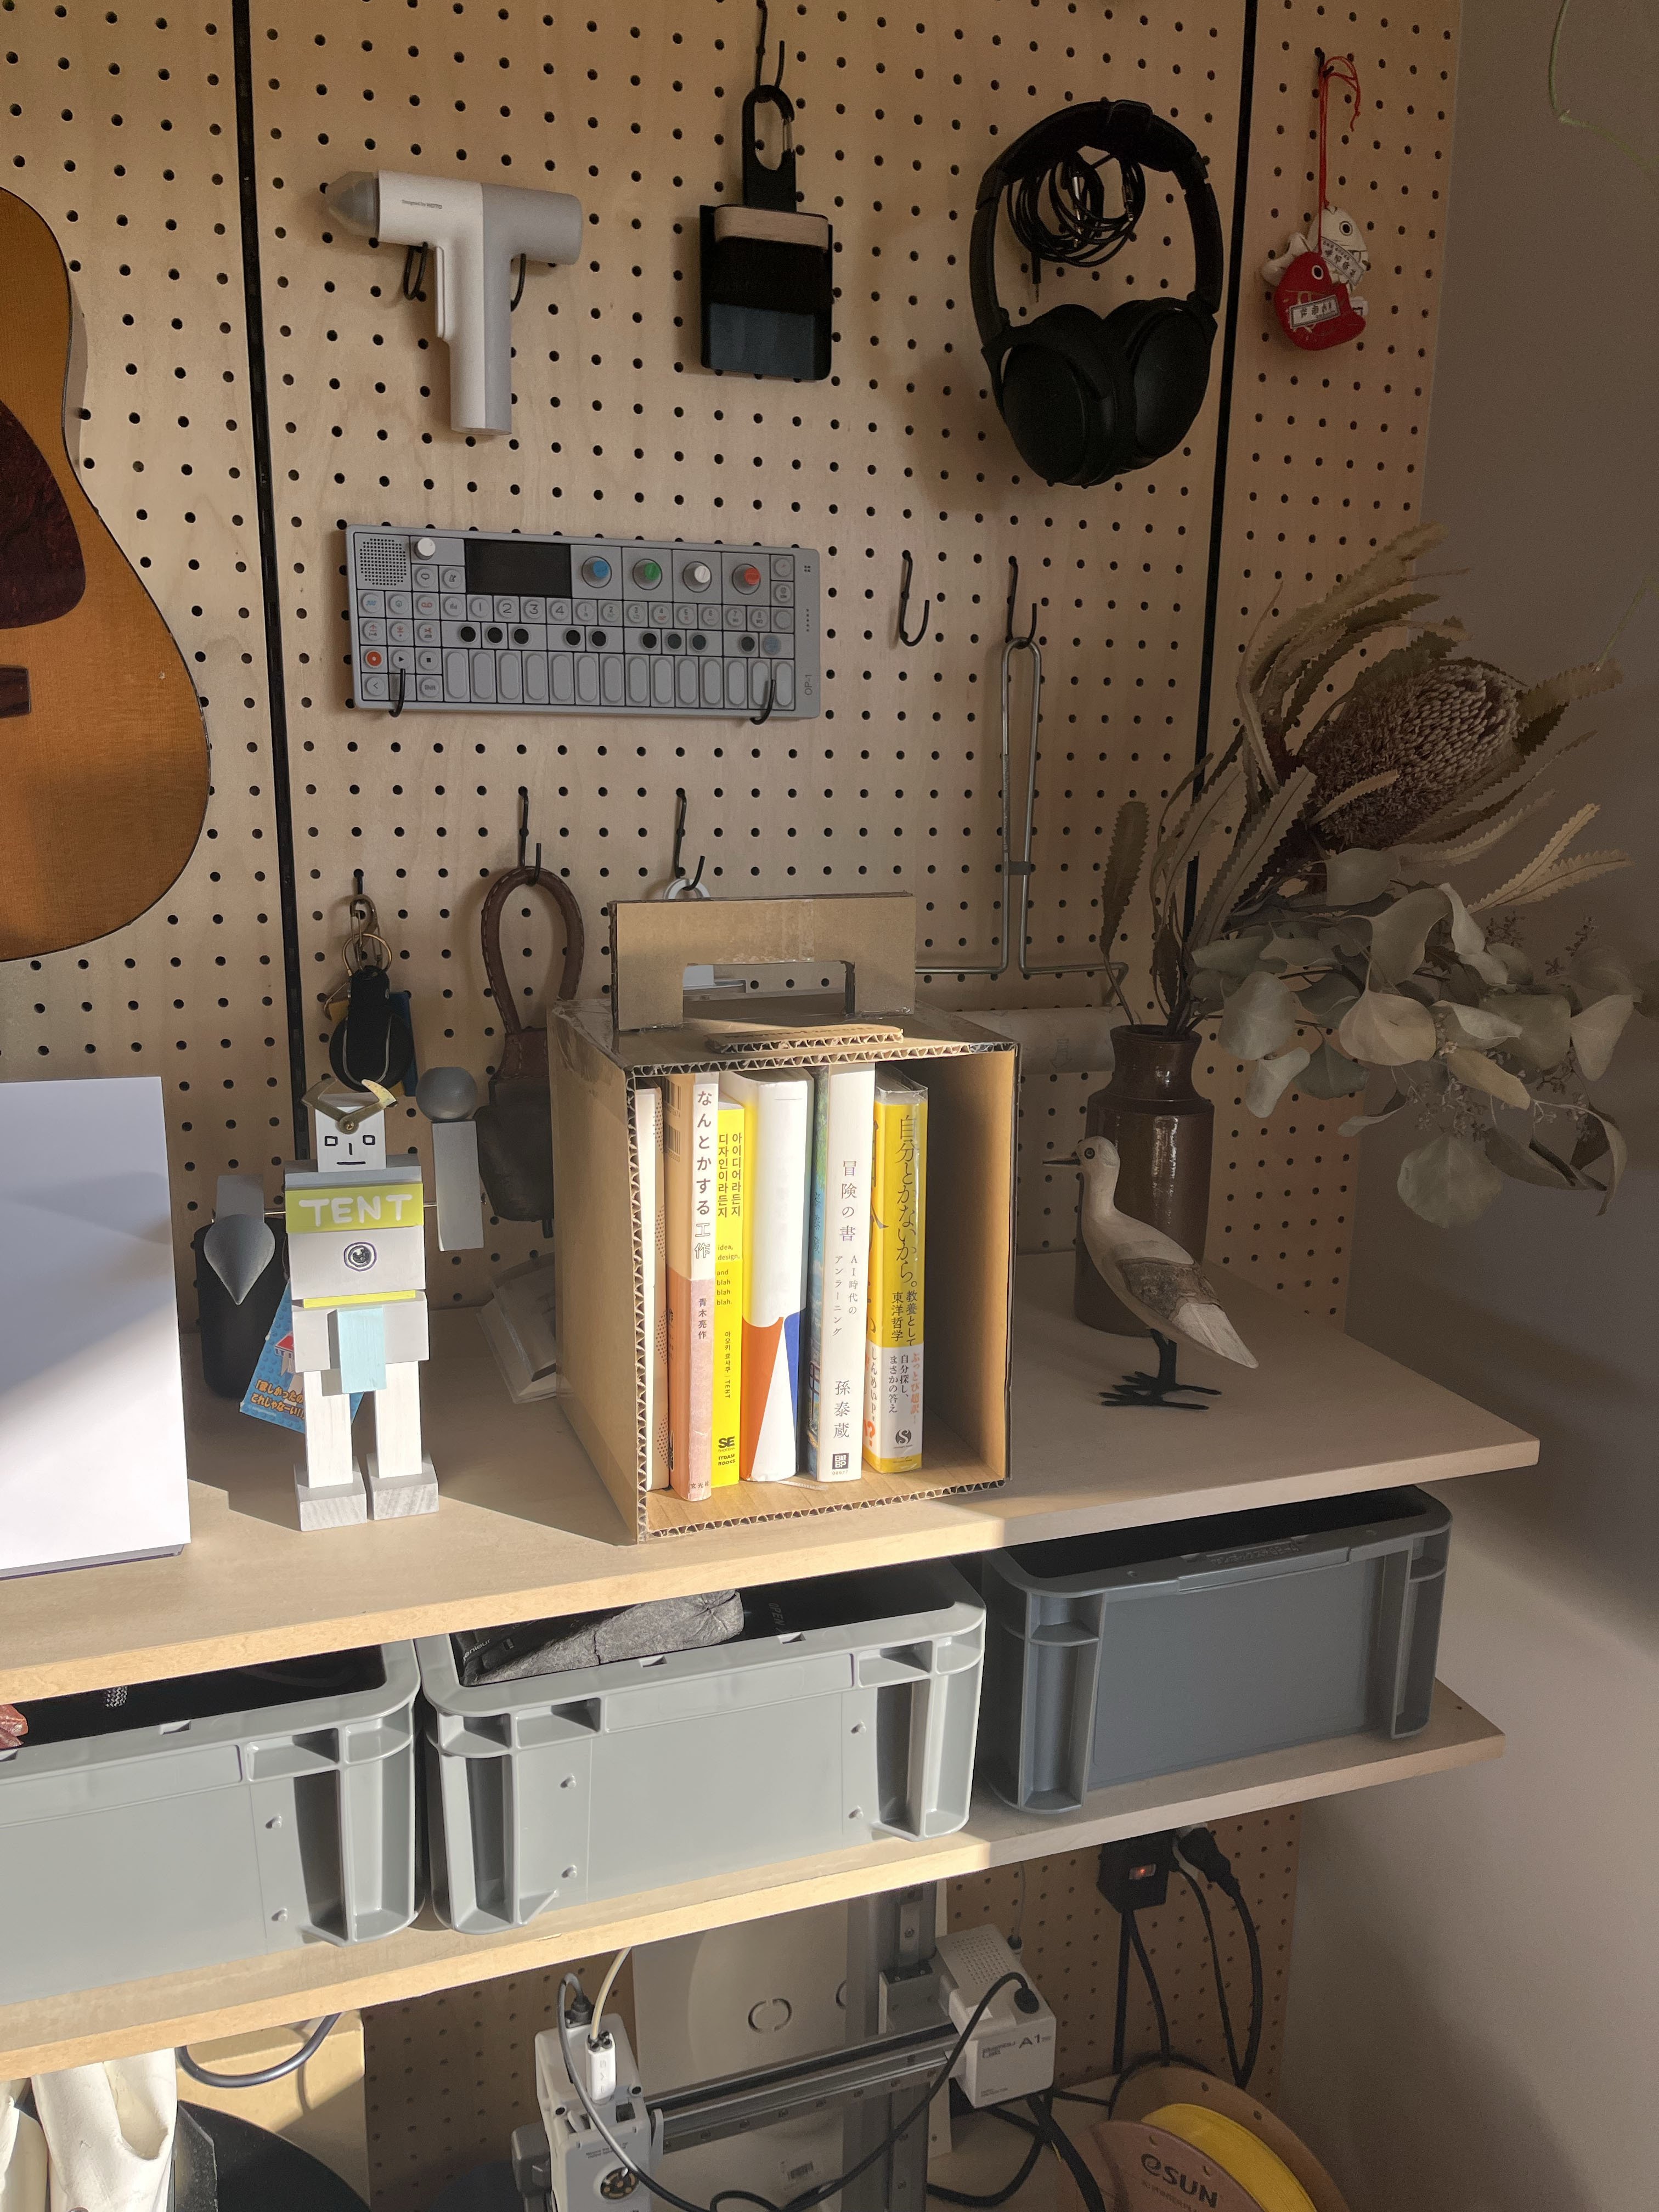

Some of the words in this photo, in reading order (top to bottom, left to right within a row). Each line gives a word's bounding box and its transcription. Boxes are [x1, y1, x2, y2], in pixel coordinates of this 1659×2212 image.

[503, 603, 512, 613] 2
[529, 605, 538, 614] 3
[555, 606, 565, 615] 4
[804, 674, 812, 696] OP-1
[693, 1090, 712, 1260] なんとかする工作
[718, 1134, 729, 1218] 디자인이라든지
[731, 1132, 742, 1217] 아이디어라든지
[839, 1159, 857, 1243] 冒険の書
[895, 1115, 918, 1288] 自分とかないから。
[298, 1193, 413, 1228] TENT
[833, 1255, 843, 1337] アンラーニング
[848, 1255, 859, 1315] AI時代の
[697, 1297, 707, 1340] 青木亮作
[890, 1291, 904, 1341] 東洋哲学
[906, 1290, 918, 1346] 教養として
[833, 1379, 851, 1440] 孫泰蔵
[888, 1355, 899, 1414] まさかの答え
[718, 1436, 735, 1448] SE
[768, 1602, 786, 1626] OPEN
[1018, 2033, 1041, 2049] A1
[1140, 2152, 1218, 2209] eSUN
